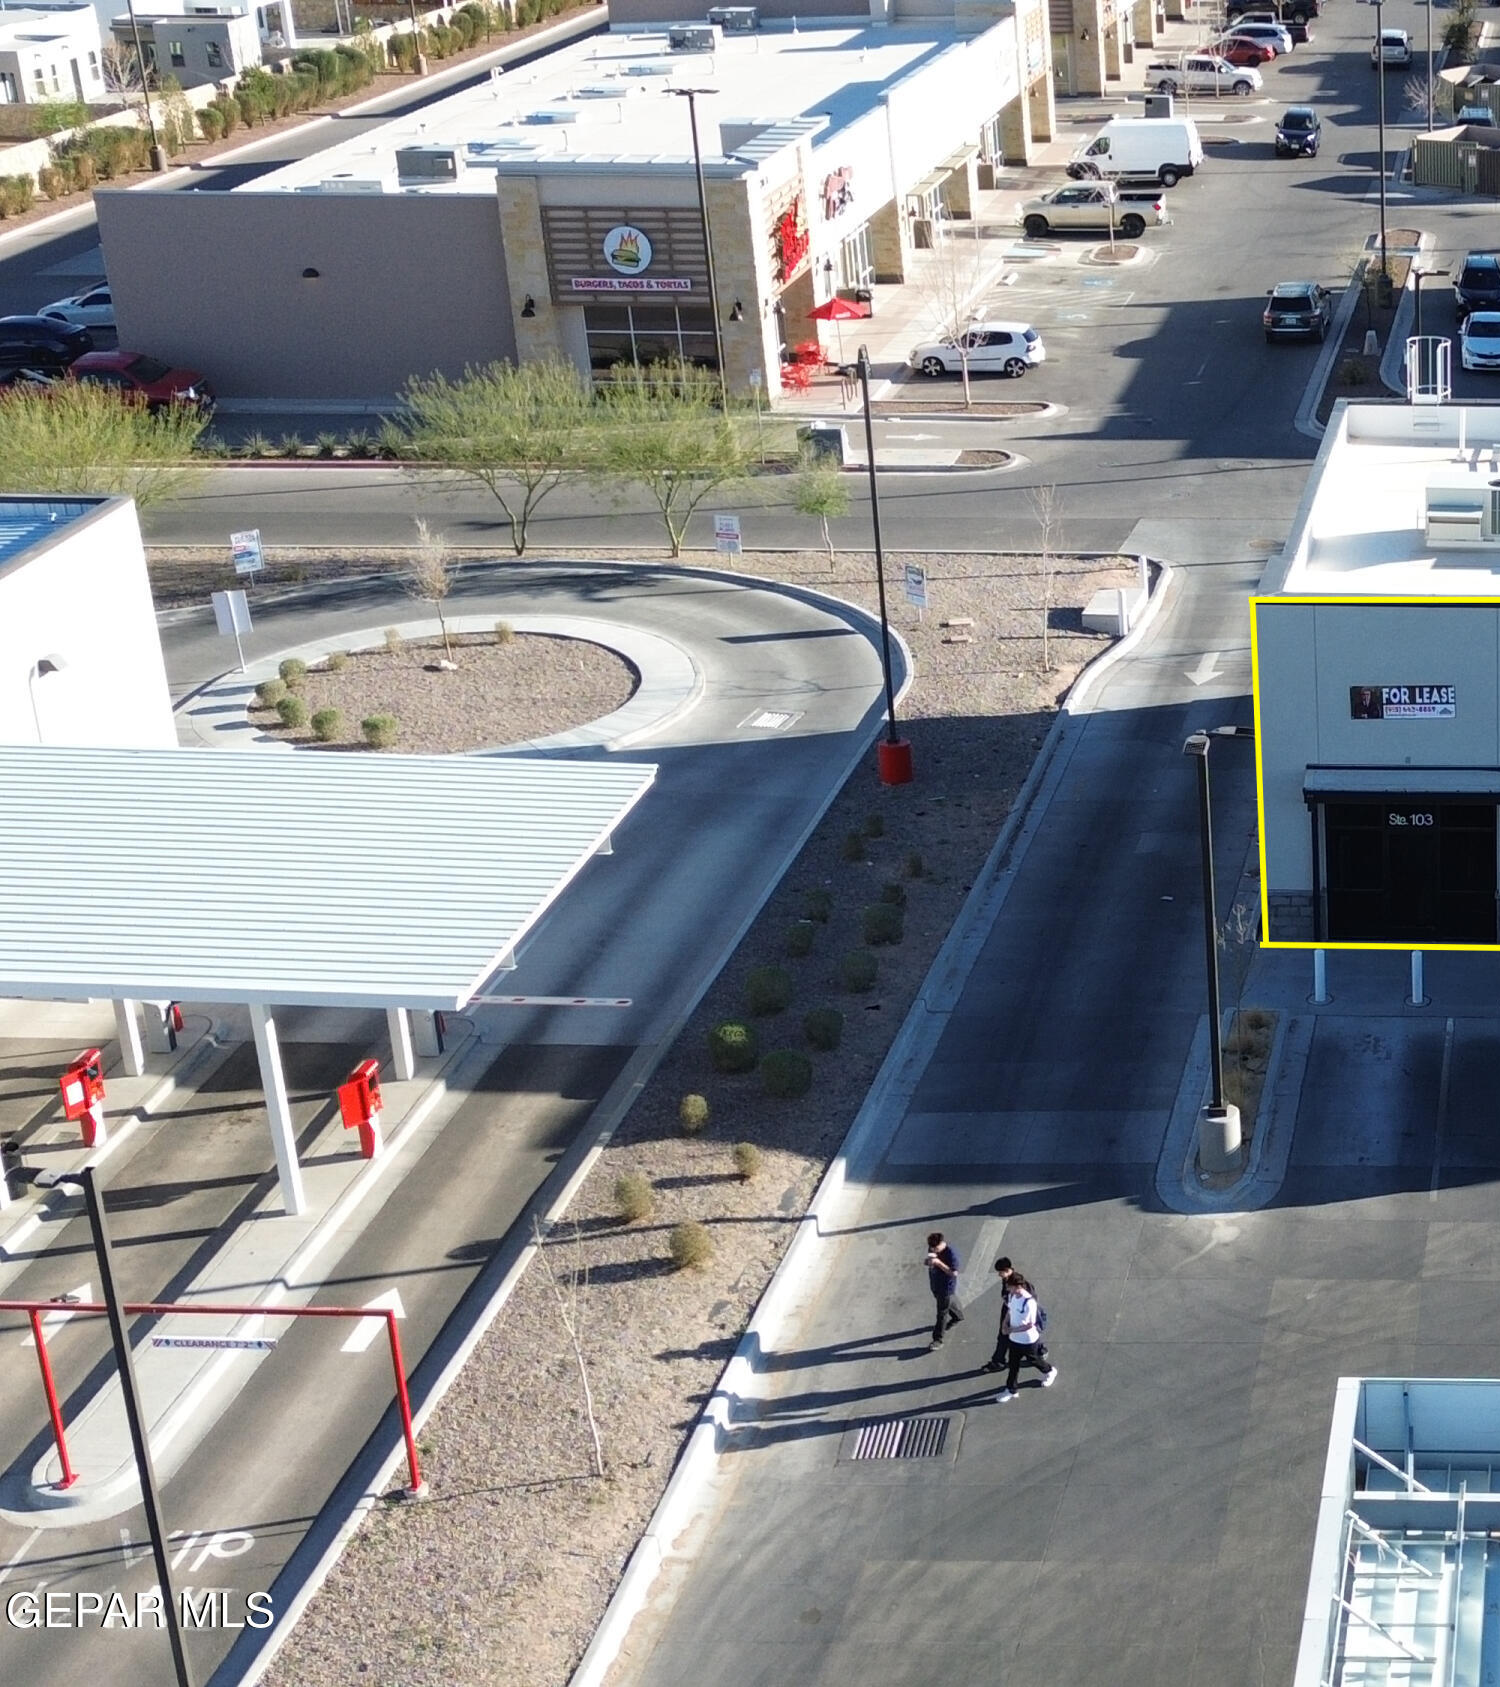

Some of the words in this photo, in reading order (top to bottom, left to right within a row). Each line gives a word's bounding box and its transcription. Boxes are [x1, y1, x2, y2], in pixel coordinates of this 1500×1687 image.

[617, 280, 645, 289] TACOS
[655, 280, 689, 289] TORTAS
[1382, 687, 1411, 704] FOR
[1415, 686, 1455, 704] LEASE
[1410, 813, 1434, 826] 103
[173, 1340, 231, 1349] CLEARANCE
